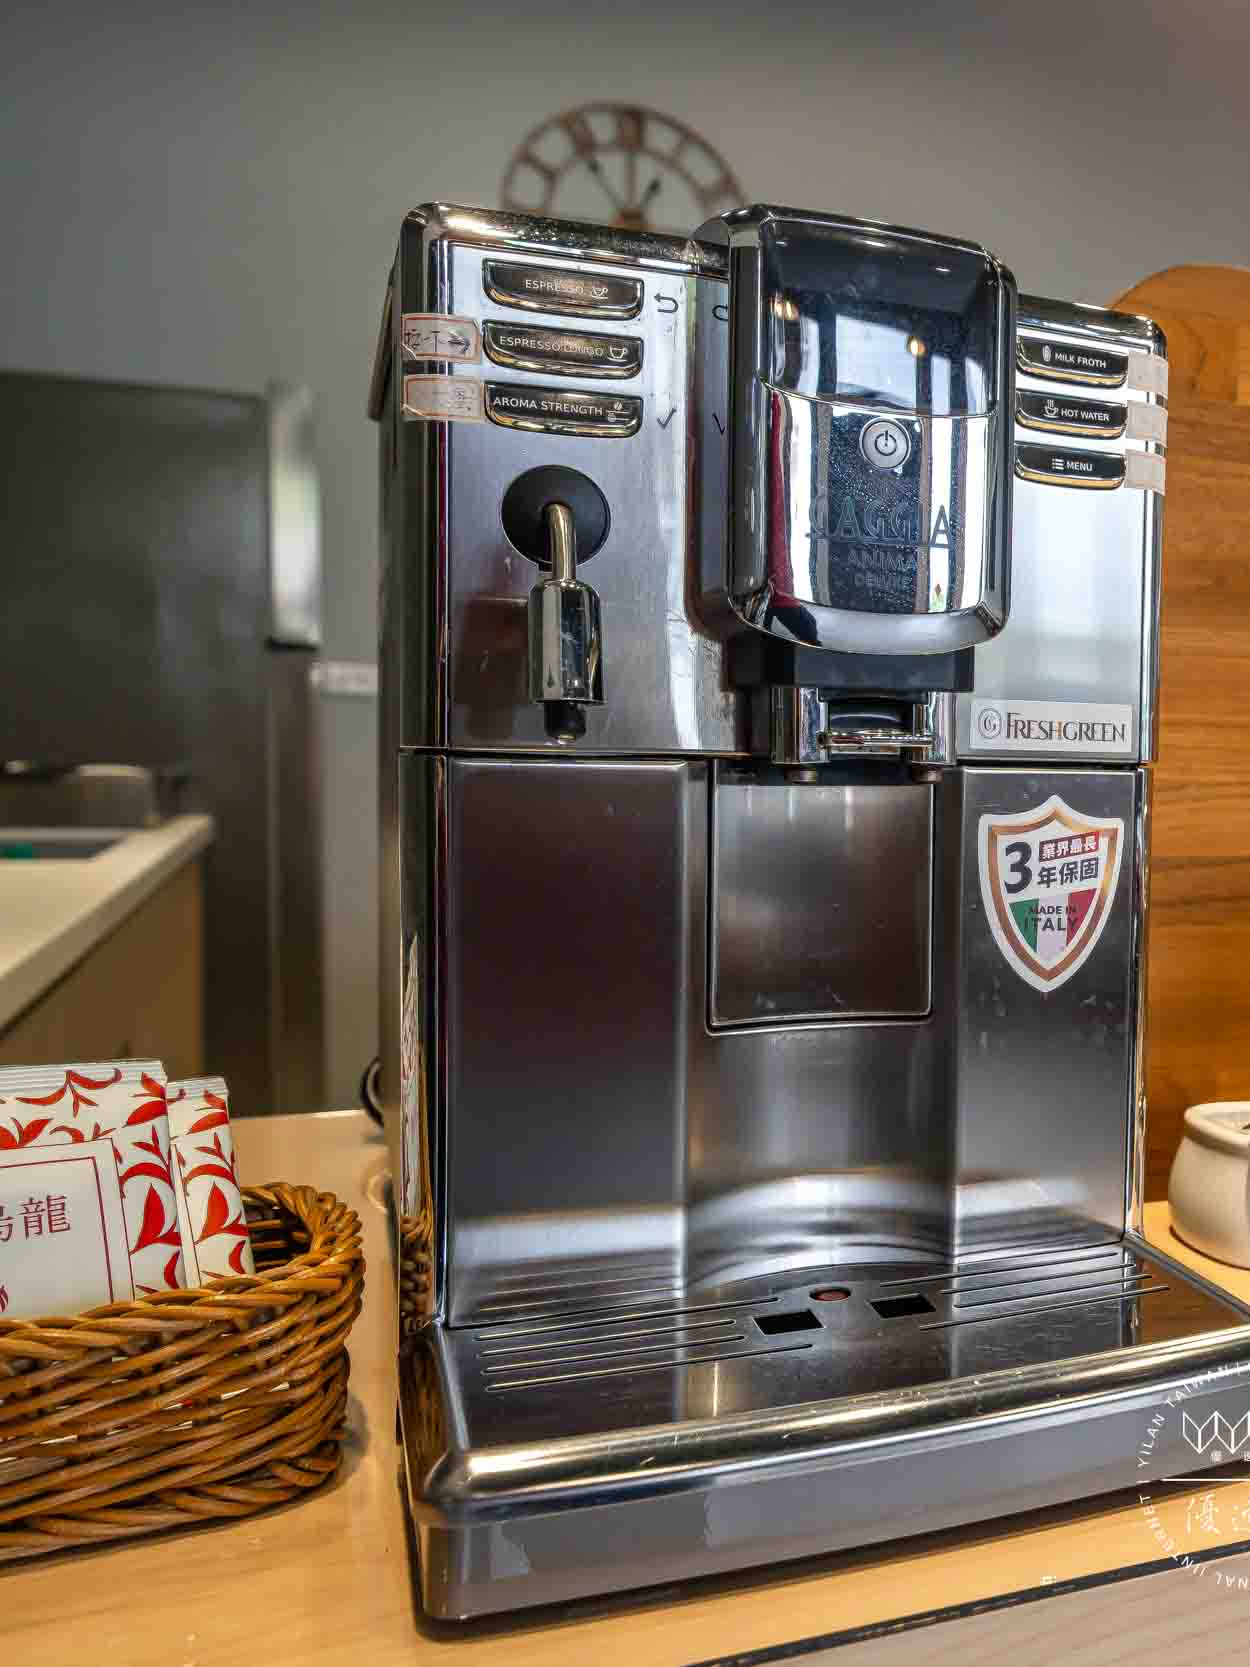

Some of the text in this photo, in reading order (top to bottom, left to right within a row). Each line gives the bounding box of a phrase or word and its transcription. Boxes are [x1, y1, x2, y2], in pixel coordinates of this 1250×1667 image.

[525, 279, 584, 295] ESPRESSO
[500, 336, 561, 352] ESPRESSO
[1055, 352, 1107, 369] MILK FROTH
[493, 397, 603, 416] AROMA STRENGTH
[1061, 408, 1110, 422] HOT WATER
[1066, 461, 1093, 472] MENU
[1006, 712, 1126, 743] FRESHGREEN
[1042, 835, 1097, 859] 業界最長
[1004, 841, 1033, 894] 3
[1037, 857, 1099, 888] 年保固
[1029, 904, 1078, 915] MADE IN
[1023, 916, 1081, 932] ITALY
